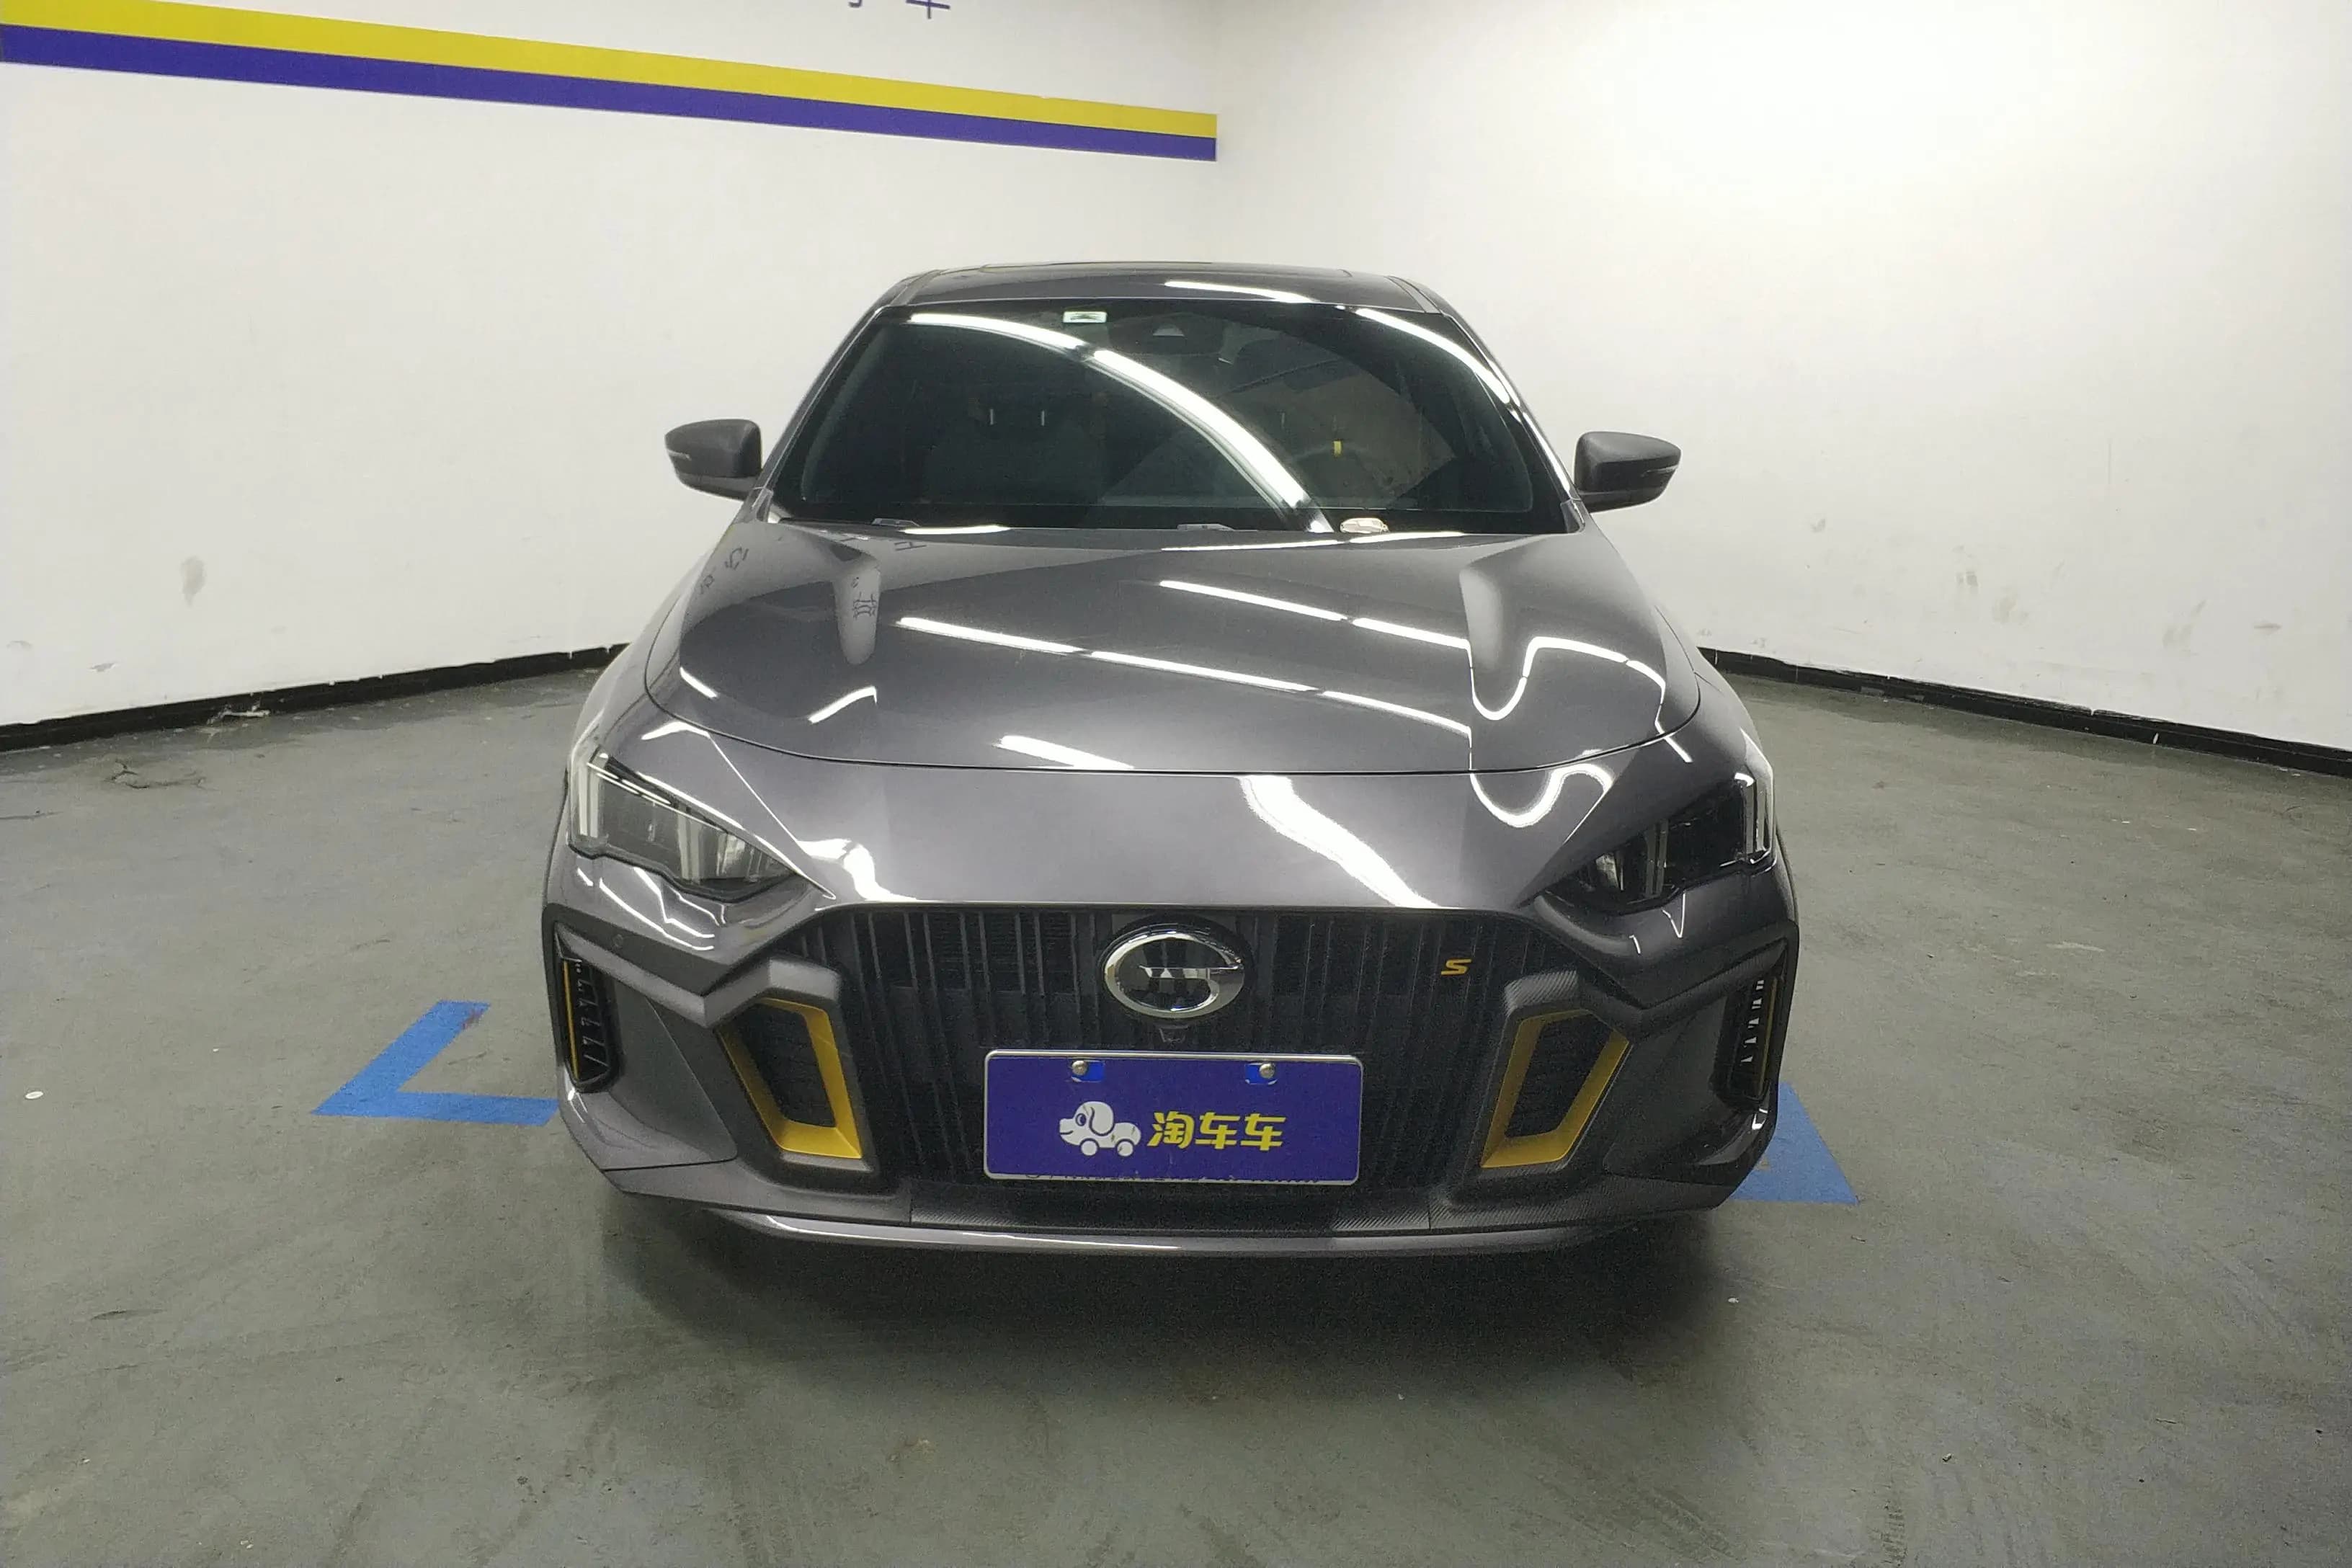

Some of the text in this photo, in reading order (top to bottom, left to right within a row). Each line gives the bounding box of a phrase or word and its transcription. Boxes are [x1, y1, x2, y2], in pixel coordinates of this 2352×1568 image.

[1440, 958, 1472, 976] S
[1146, 1110, 1286, 1151] 淘车车
